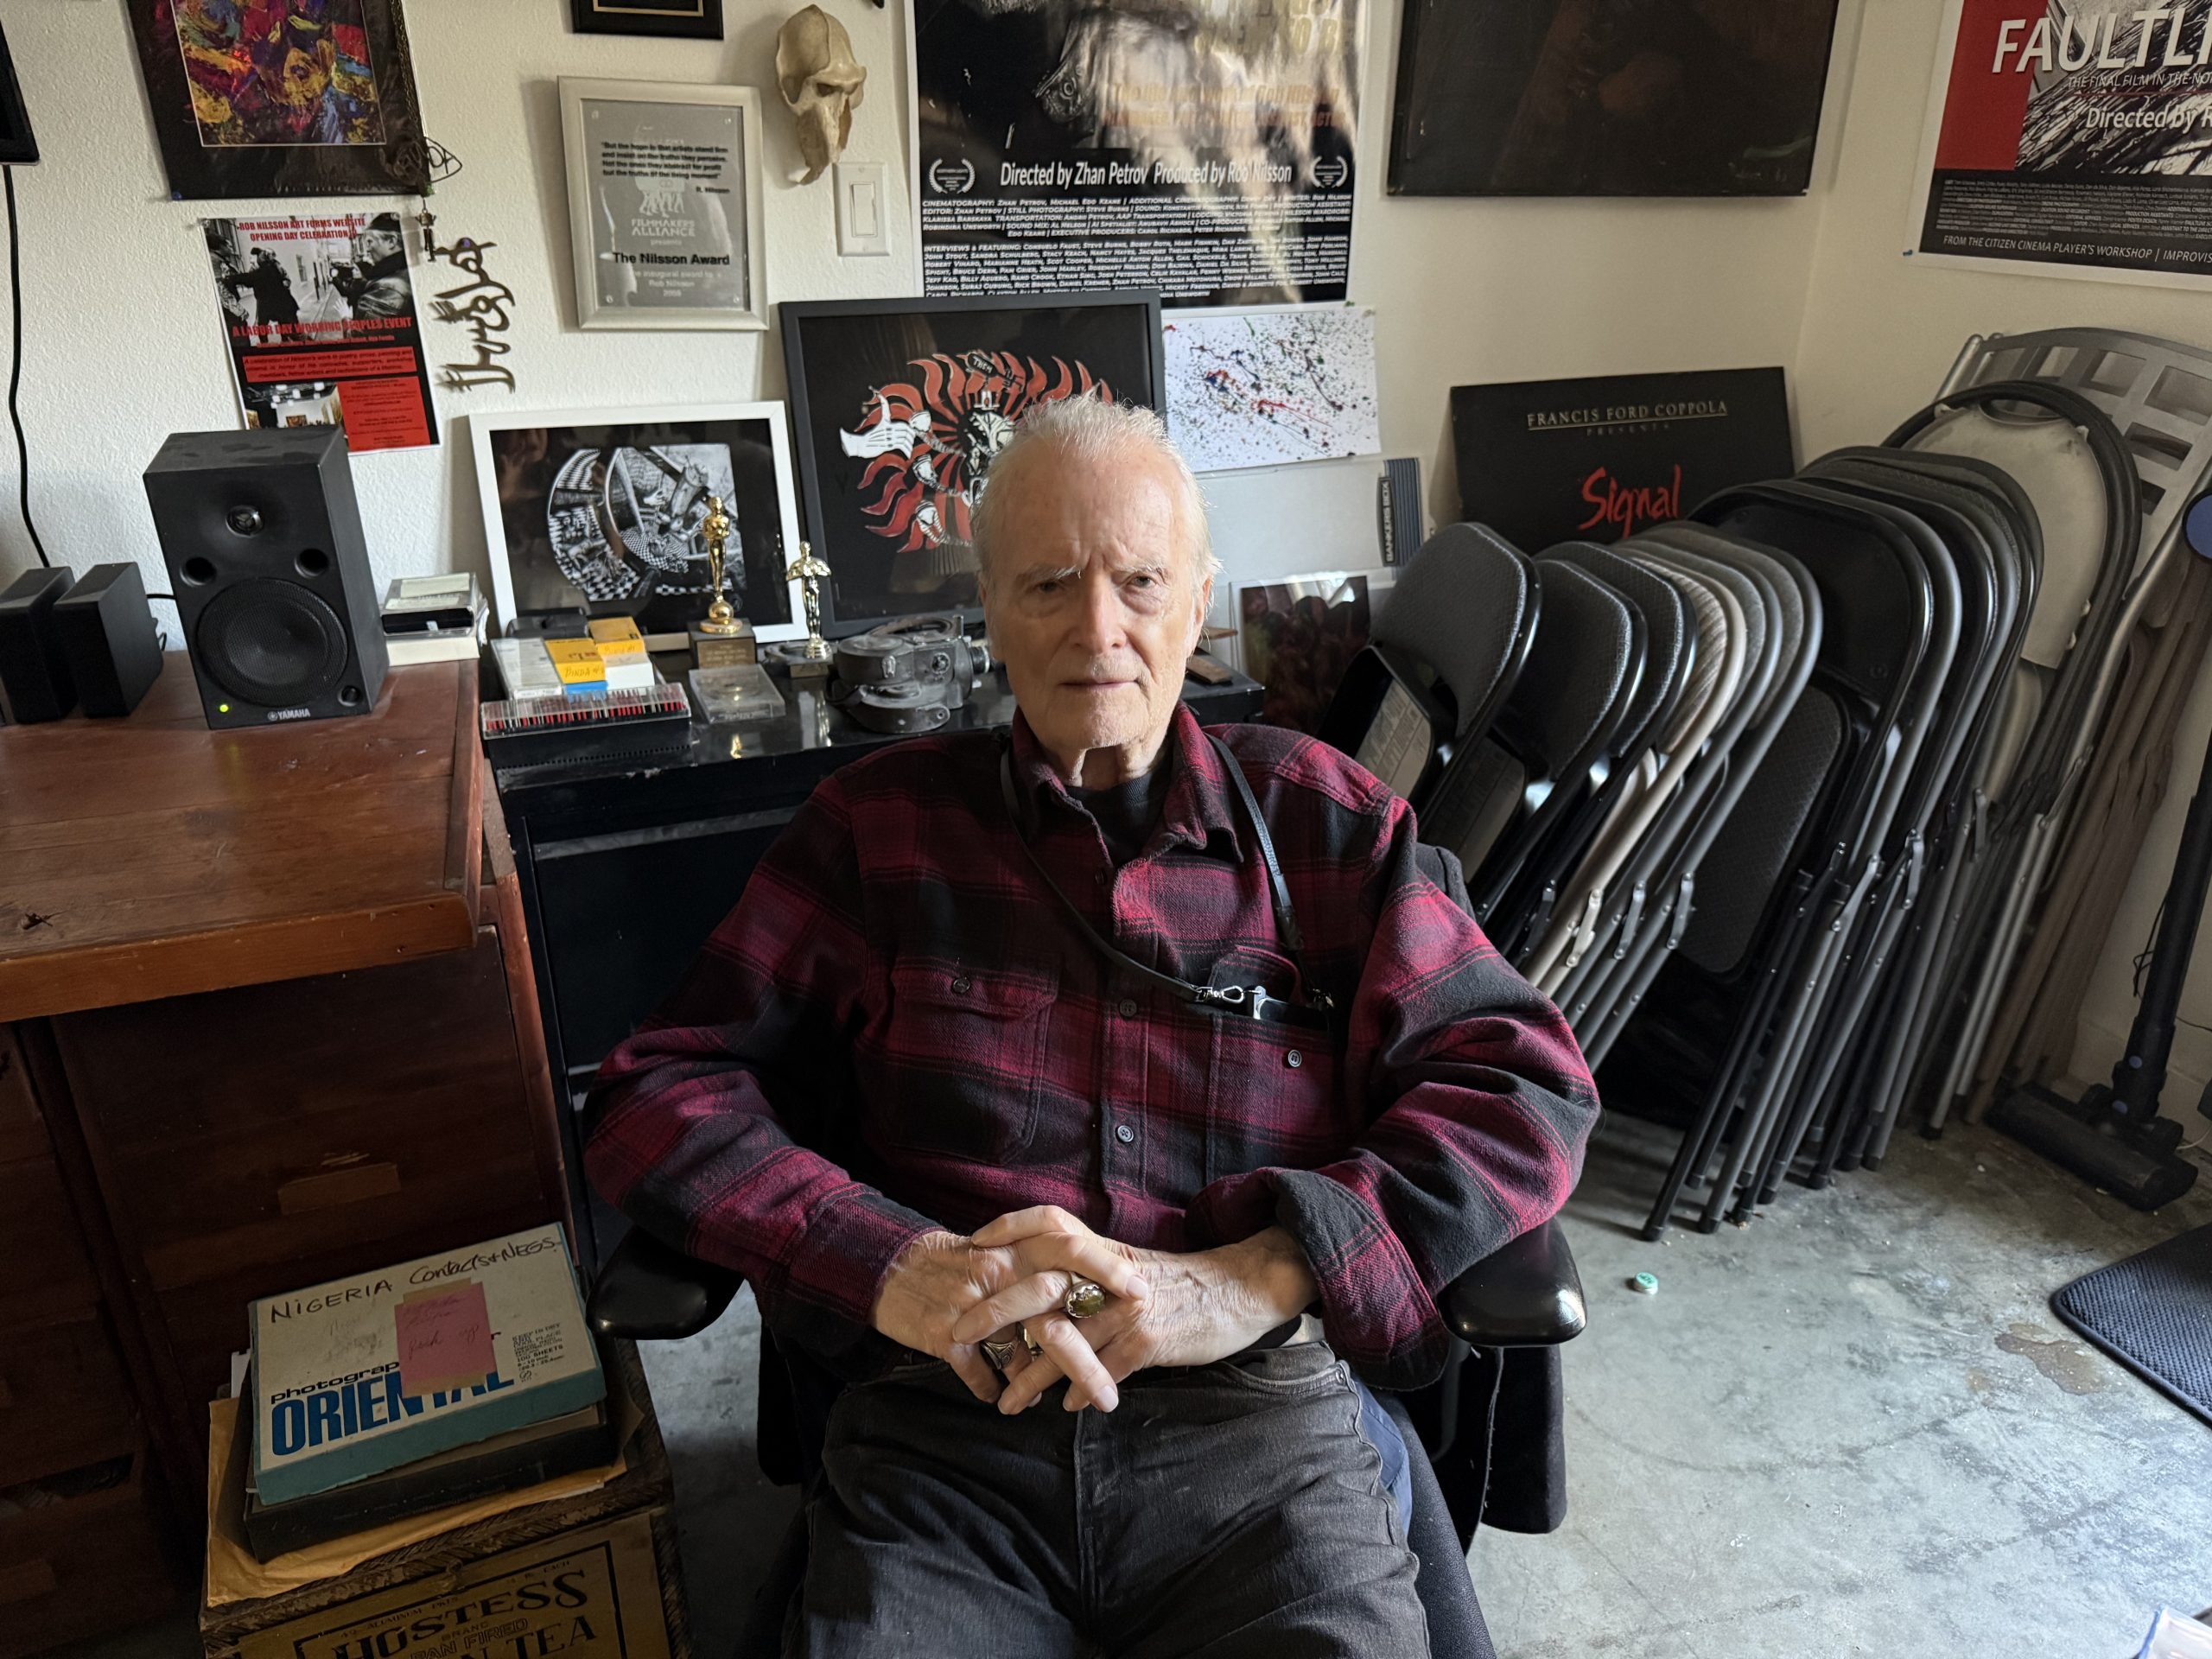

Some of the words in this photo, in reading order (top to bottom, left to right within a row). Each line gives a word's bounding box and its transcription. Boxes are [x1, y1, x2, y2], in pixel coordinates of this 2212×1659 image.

[2068, 77, 2087, 90] THE
[2089, 76, 2121, 89] FINAL
[2122, 75, 2150, 87] FILM
[2151, 75, 2164, 86] IN
[2169, 74, 2190, 86] THE
[2085, 106, 2168, 129] Directed
[2170, 109, 2198, 135] by
[1000, 162, 1055, 185] Directed
[1057, 162, 1072, 189] by
[1073, 162, 1106, 185] Zhan
[1108, 162, 1148, 185] Petrov
[1152, 162, 1209, 185] Produced
[1210, 161, 1226, 188] by
[1248, 160, 1293, 184] Nilsson
[922, 200, 995, 208] CINEMATOGRAPHY:
[257, 220, 289, 231] NILSSON
[289, 219, 304, 229] ART
[306, 219, 332, 228] FORMS
[332, 218, 365, 227] WEBSITE
[632, 219, 695, 228] FILMMAKERS
[632, 227, 696, 237] ALLIANCE
[1050, 228, 1090, 237] EXECUTIVE
[250, 232, 283, 242] OPENING
[284, 232, 298, 241] DAY
[299, 229, 349, 240] CELEBRATION
[1943, 234, 1968, 246] FROM
[1968, 236, 1984, 246] THE
[1984, 237, 2018, 249] CITIZEN
[2018, 239, 2051, 251] CINEMA
[2052, 241, 2094, 255] PLAYER'S
[2096, 245, 2153, 258] WORKSHOP
[977, 243, 1023, 251] FEATURING:
[613, 252, 637, 264] The
[640, 253, 688, 264] Nilsson
[691, 254, 730, 265] Award
[233, 326, 241, 336] A
[242, 324, 273, 335] LABOR
[276, 323, 293, 334] DAY
[295, 320, 341, 334] WORKING
[385, 317, 412, 328] EVENT
[1527, 407, 1600, 427] FRANCIS
[1606, 405, 1650, 422] FORD
[1654, 400, 1727, 417] COPPOLA
[1382, 481, 1391, 507] BOX
[1578, 463, 1682, 540] Signal
[1383, 508, 1394, 562] BANKERS
[277, 708, 311, 721] YAMAHA
[270, 1278, 393, 1325] NIGERIA
[330, 1568, 588, 1659] HOSTESS
[464, 1617, 529, 1649] FIRED
[505, 1614, 599, 1659] TEA
